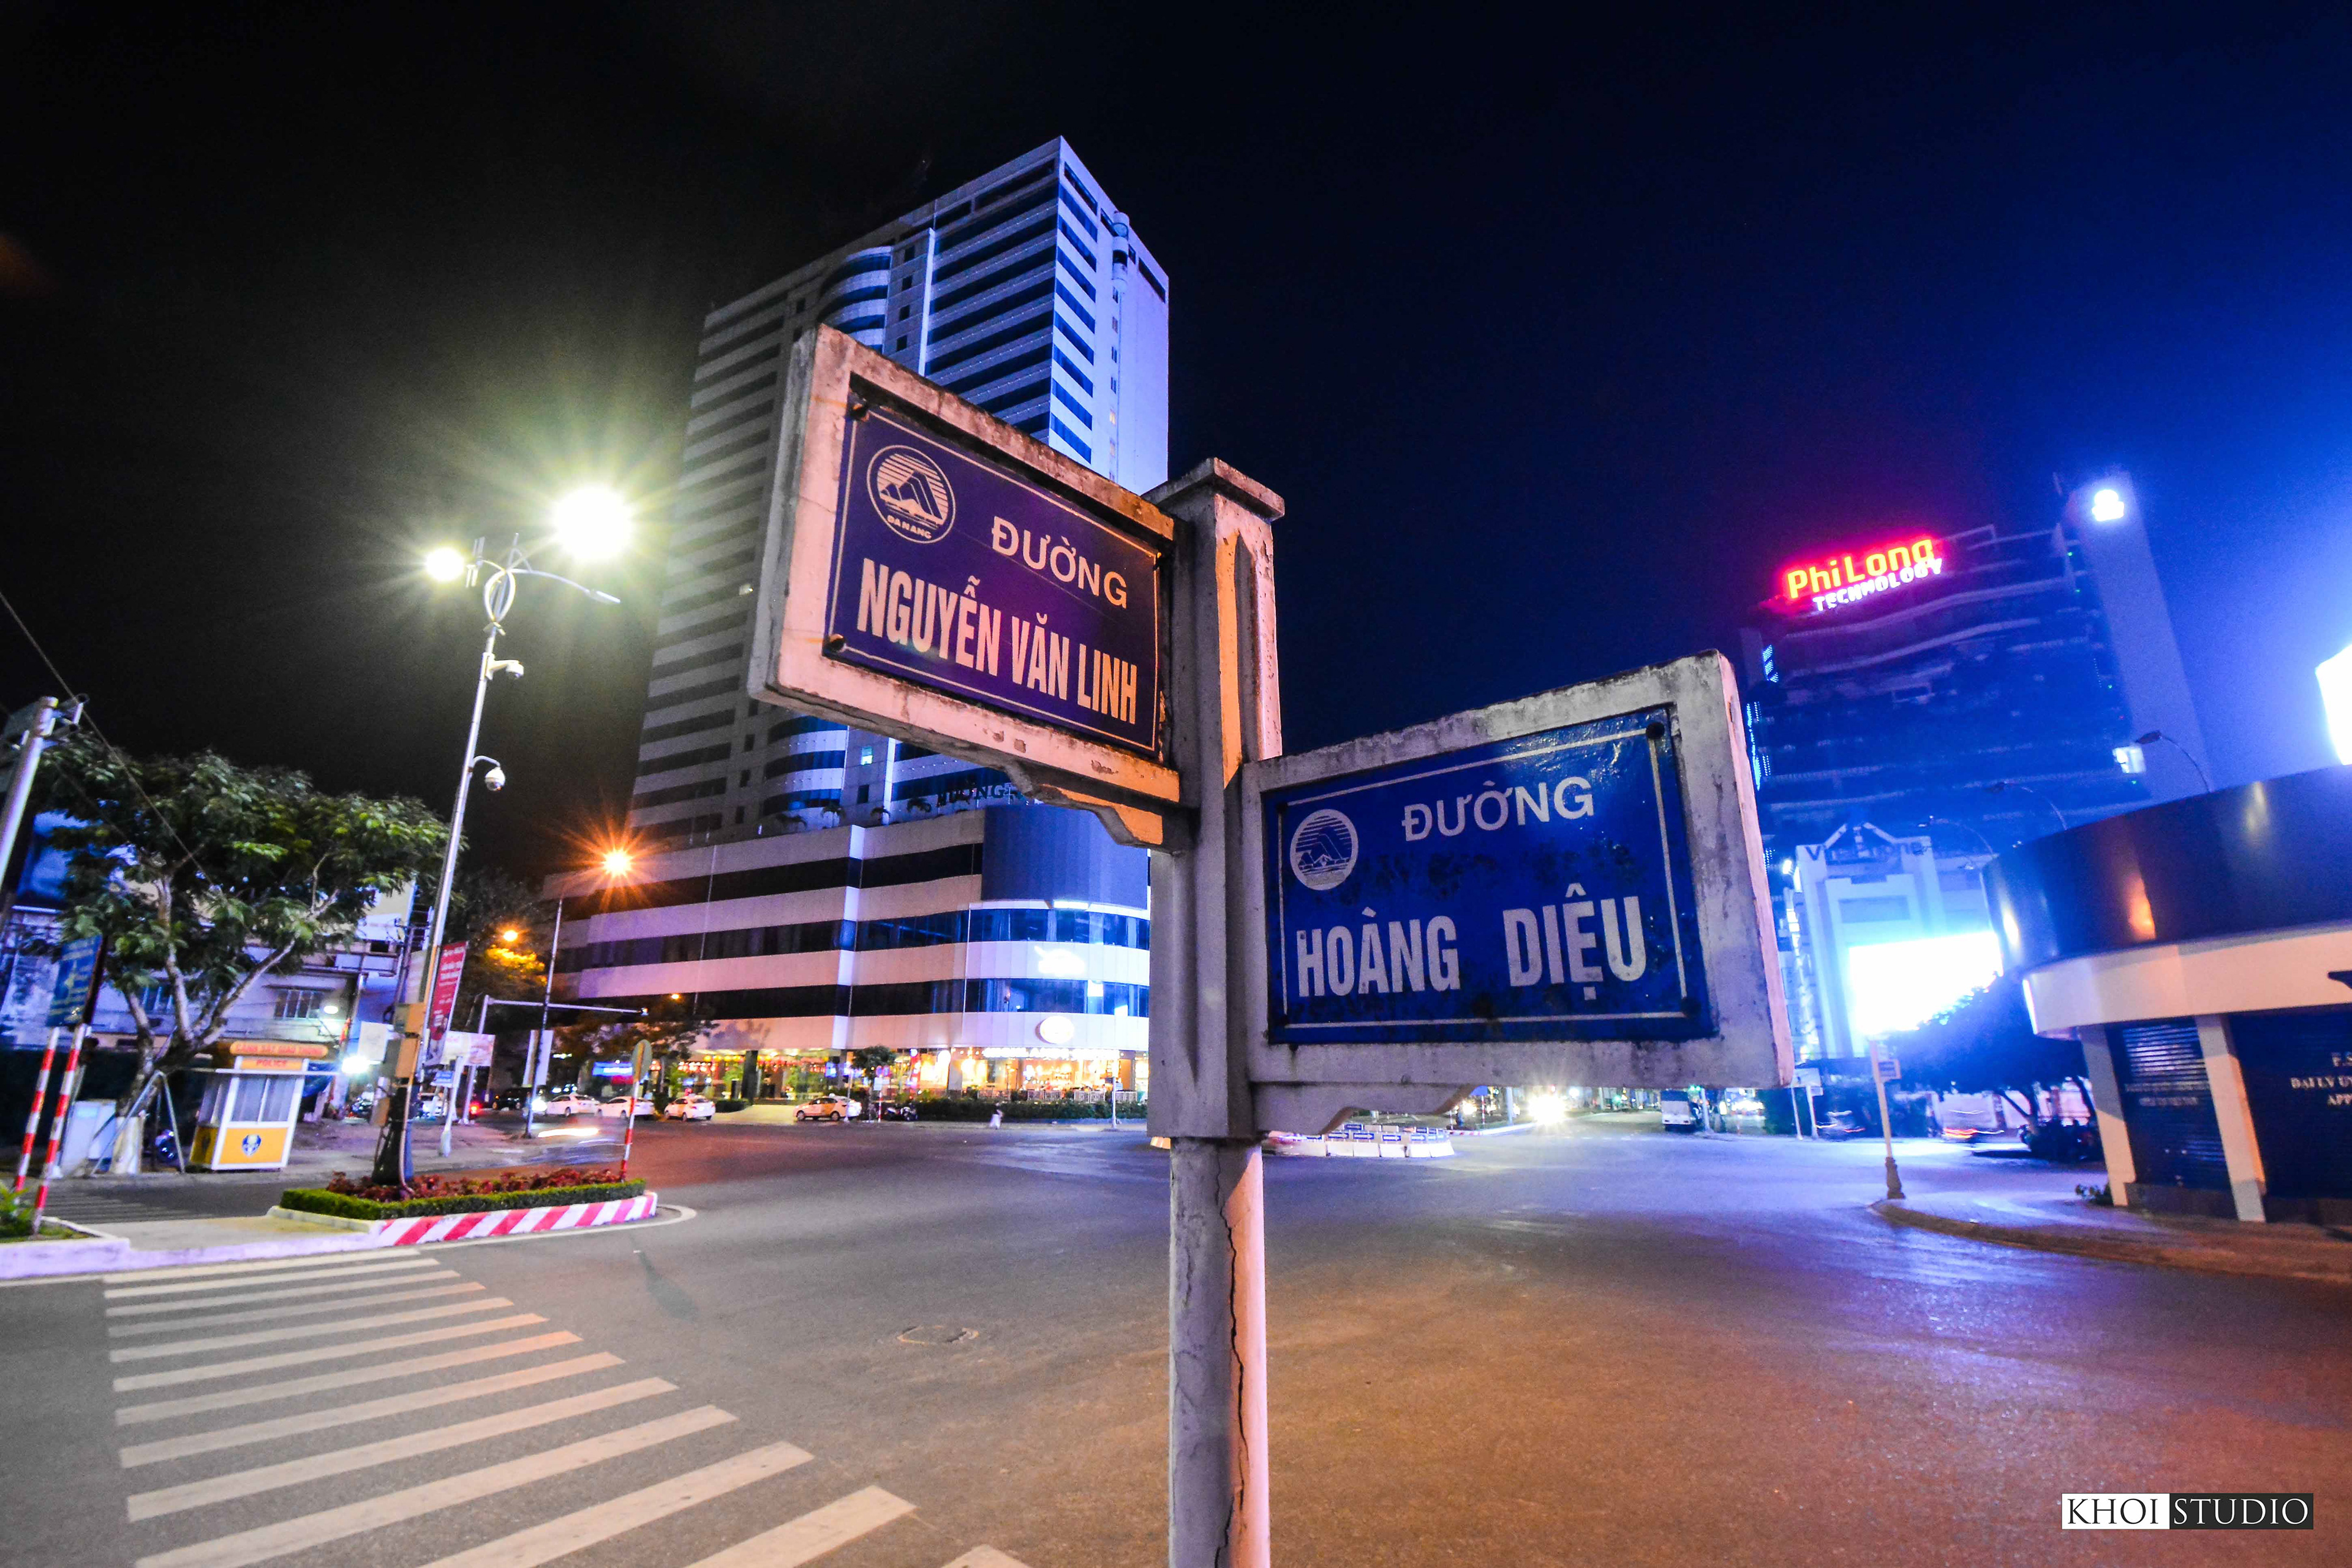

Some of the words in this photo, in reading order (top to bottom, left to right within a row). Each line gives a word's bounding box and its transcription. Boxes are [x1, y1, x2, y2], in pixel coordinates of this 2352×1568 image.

[991, 516, 1127, 609] ĐƯỜNG
[1812, 558, 1942, 611] TECHNOLOGY
[857, 557, 1001, 676] NGUYỄN
[1011, 612, 1069, 701] VĂN
[1077, 643, 1137, 724] LINH
[1401, 776, 1594, 842] ĐƯỜNG
[1297, 907, 1460, 997] HOÀNG
[1502, 883, 1646, 1000] DIỆU
